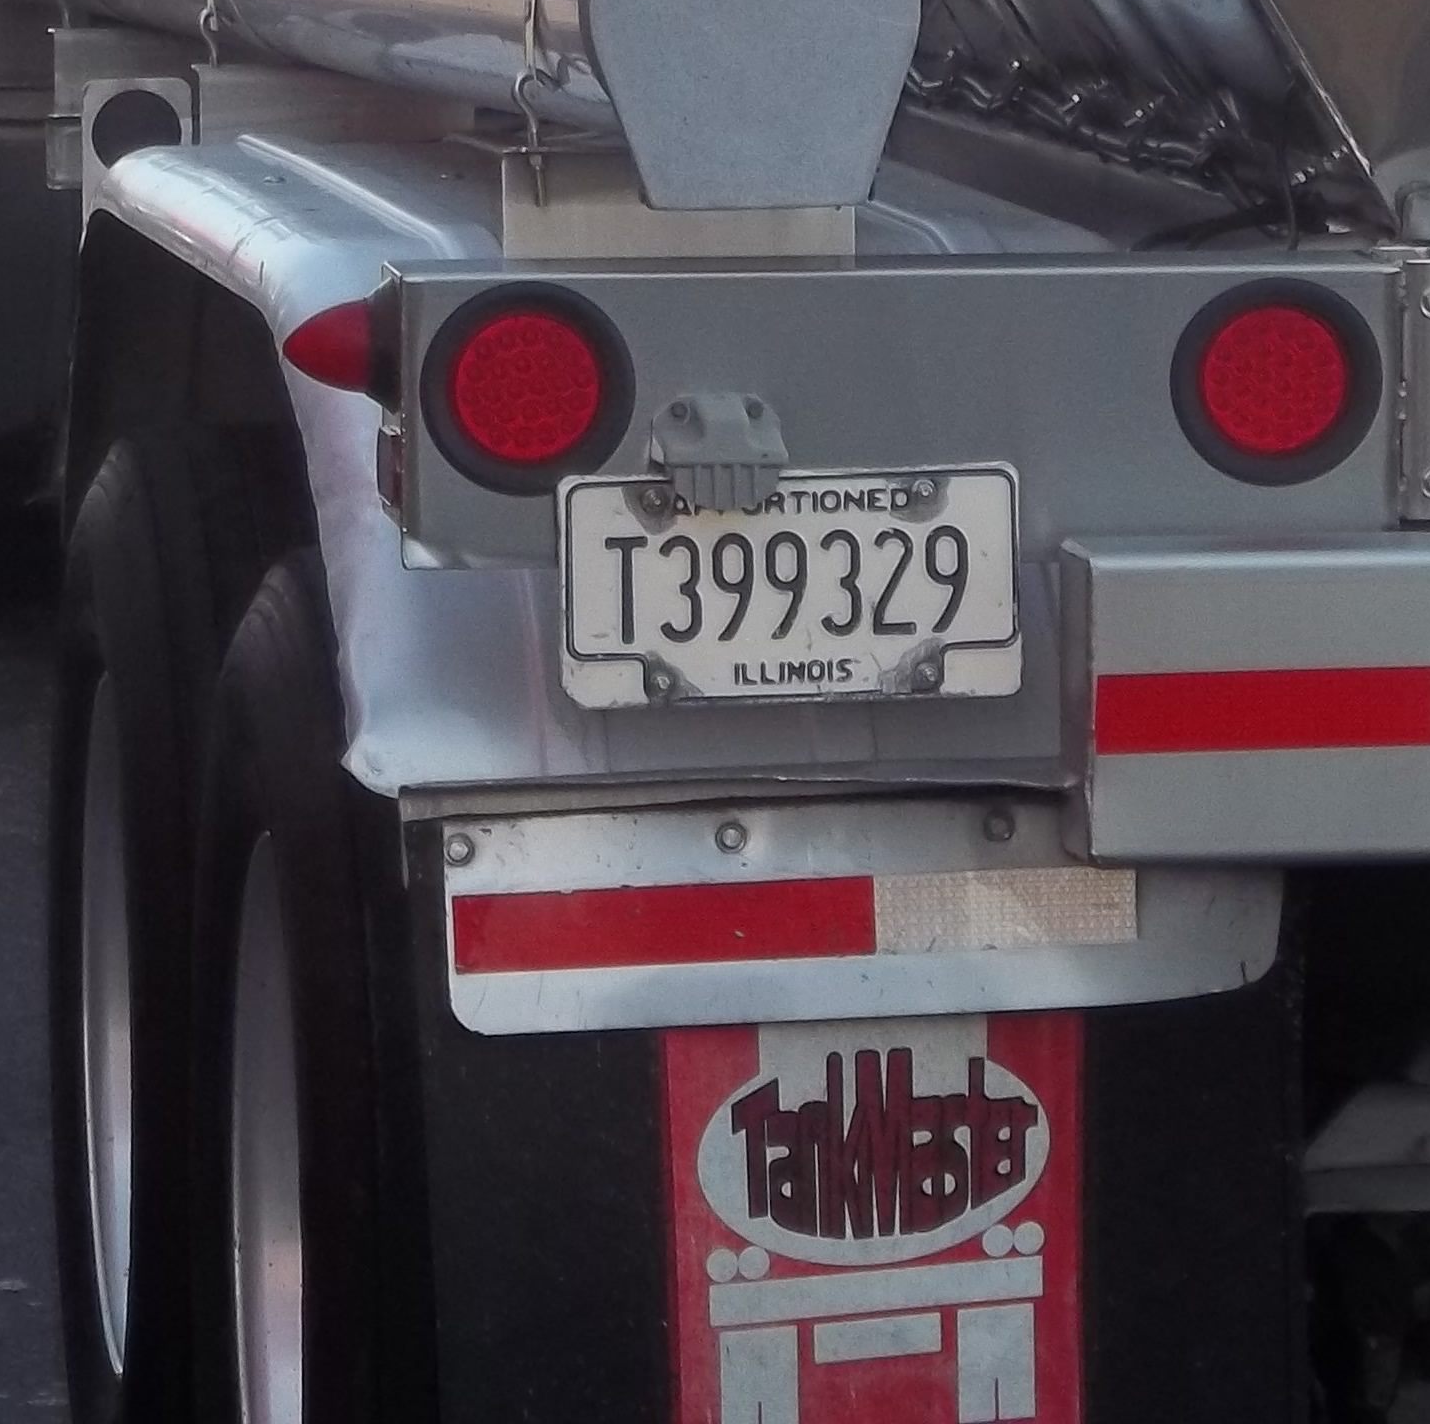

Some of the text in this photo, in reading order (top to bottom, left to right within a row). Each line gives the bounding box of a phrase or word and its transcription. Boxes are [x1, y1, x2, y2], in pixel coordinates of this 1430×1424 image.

[672, 487, 910, 516] ARTIONED
[604, 524, 970, 645] T399329
[733, 657, 856, 687] ILLINOIS
[730, 1046, 1039, 1241] TankMaster
